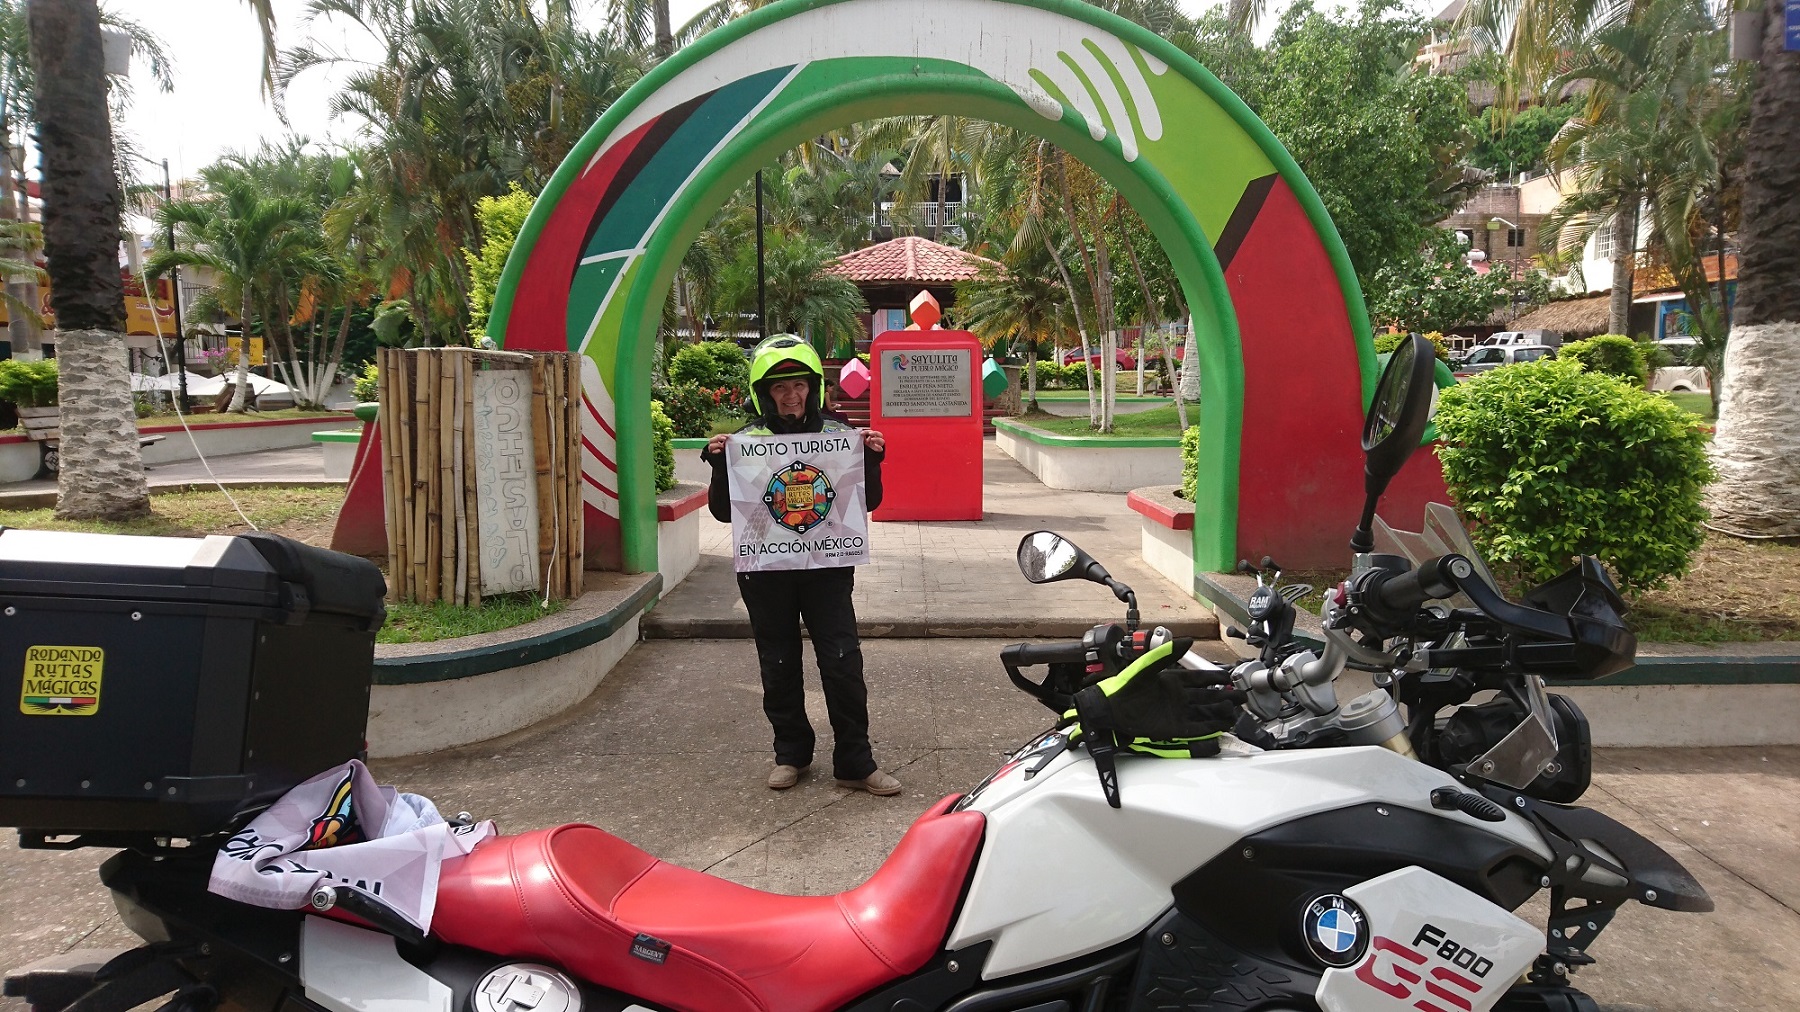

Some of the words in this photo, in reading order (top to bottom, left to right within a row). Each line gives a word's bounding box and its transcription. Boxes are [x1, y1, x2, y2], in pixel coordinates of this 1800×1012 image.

[741, 442, 788, 457] MOTO
[791, 437, 851, 455] TURISTA
[739, 544, 757, 557] EN
[759, 539, 811, 555] ACCIÓN
[814, 535, 863, 551] MÉXICO
[1250, 596, 1268, 604] RAM
[1311, 897, 1363, 923] BMW
[634, 944, 664, 958] SARGENT
[1412, 923, 1494, 978] F800
[1355, 935, 1483, 1012] GS
